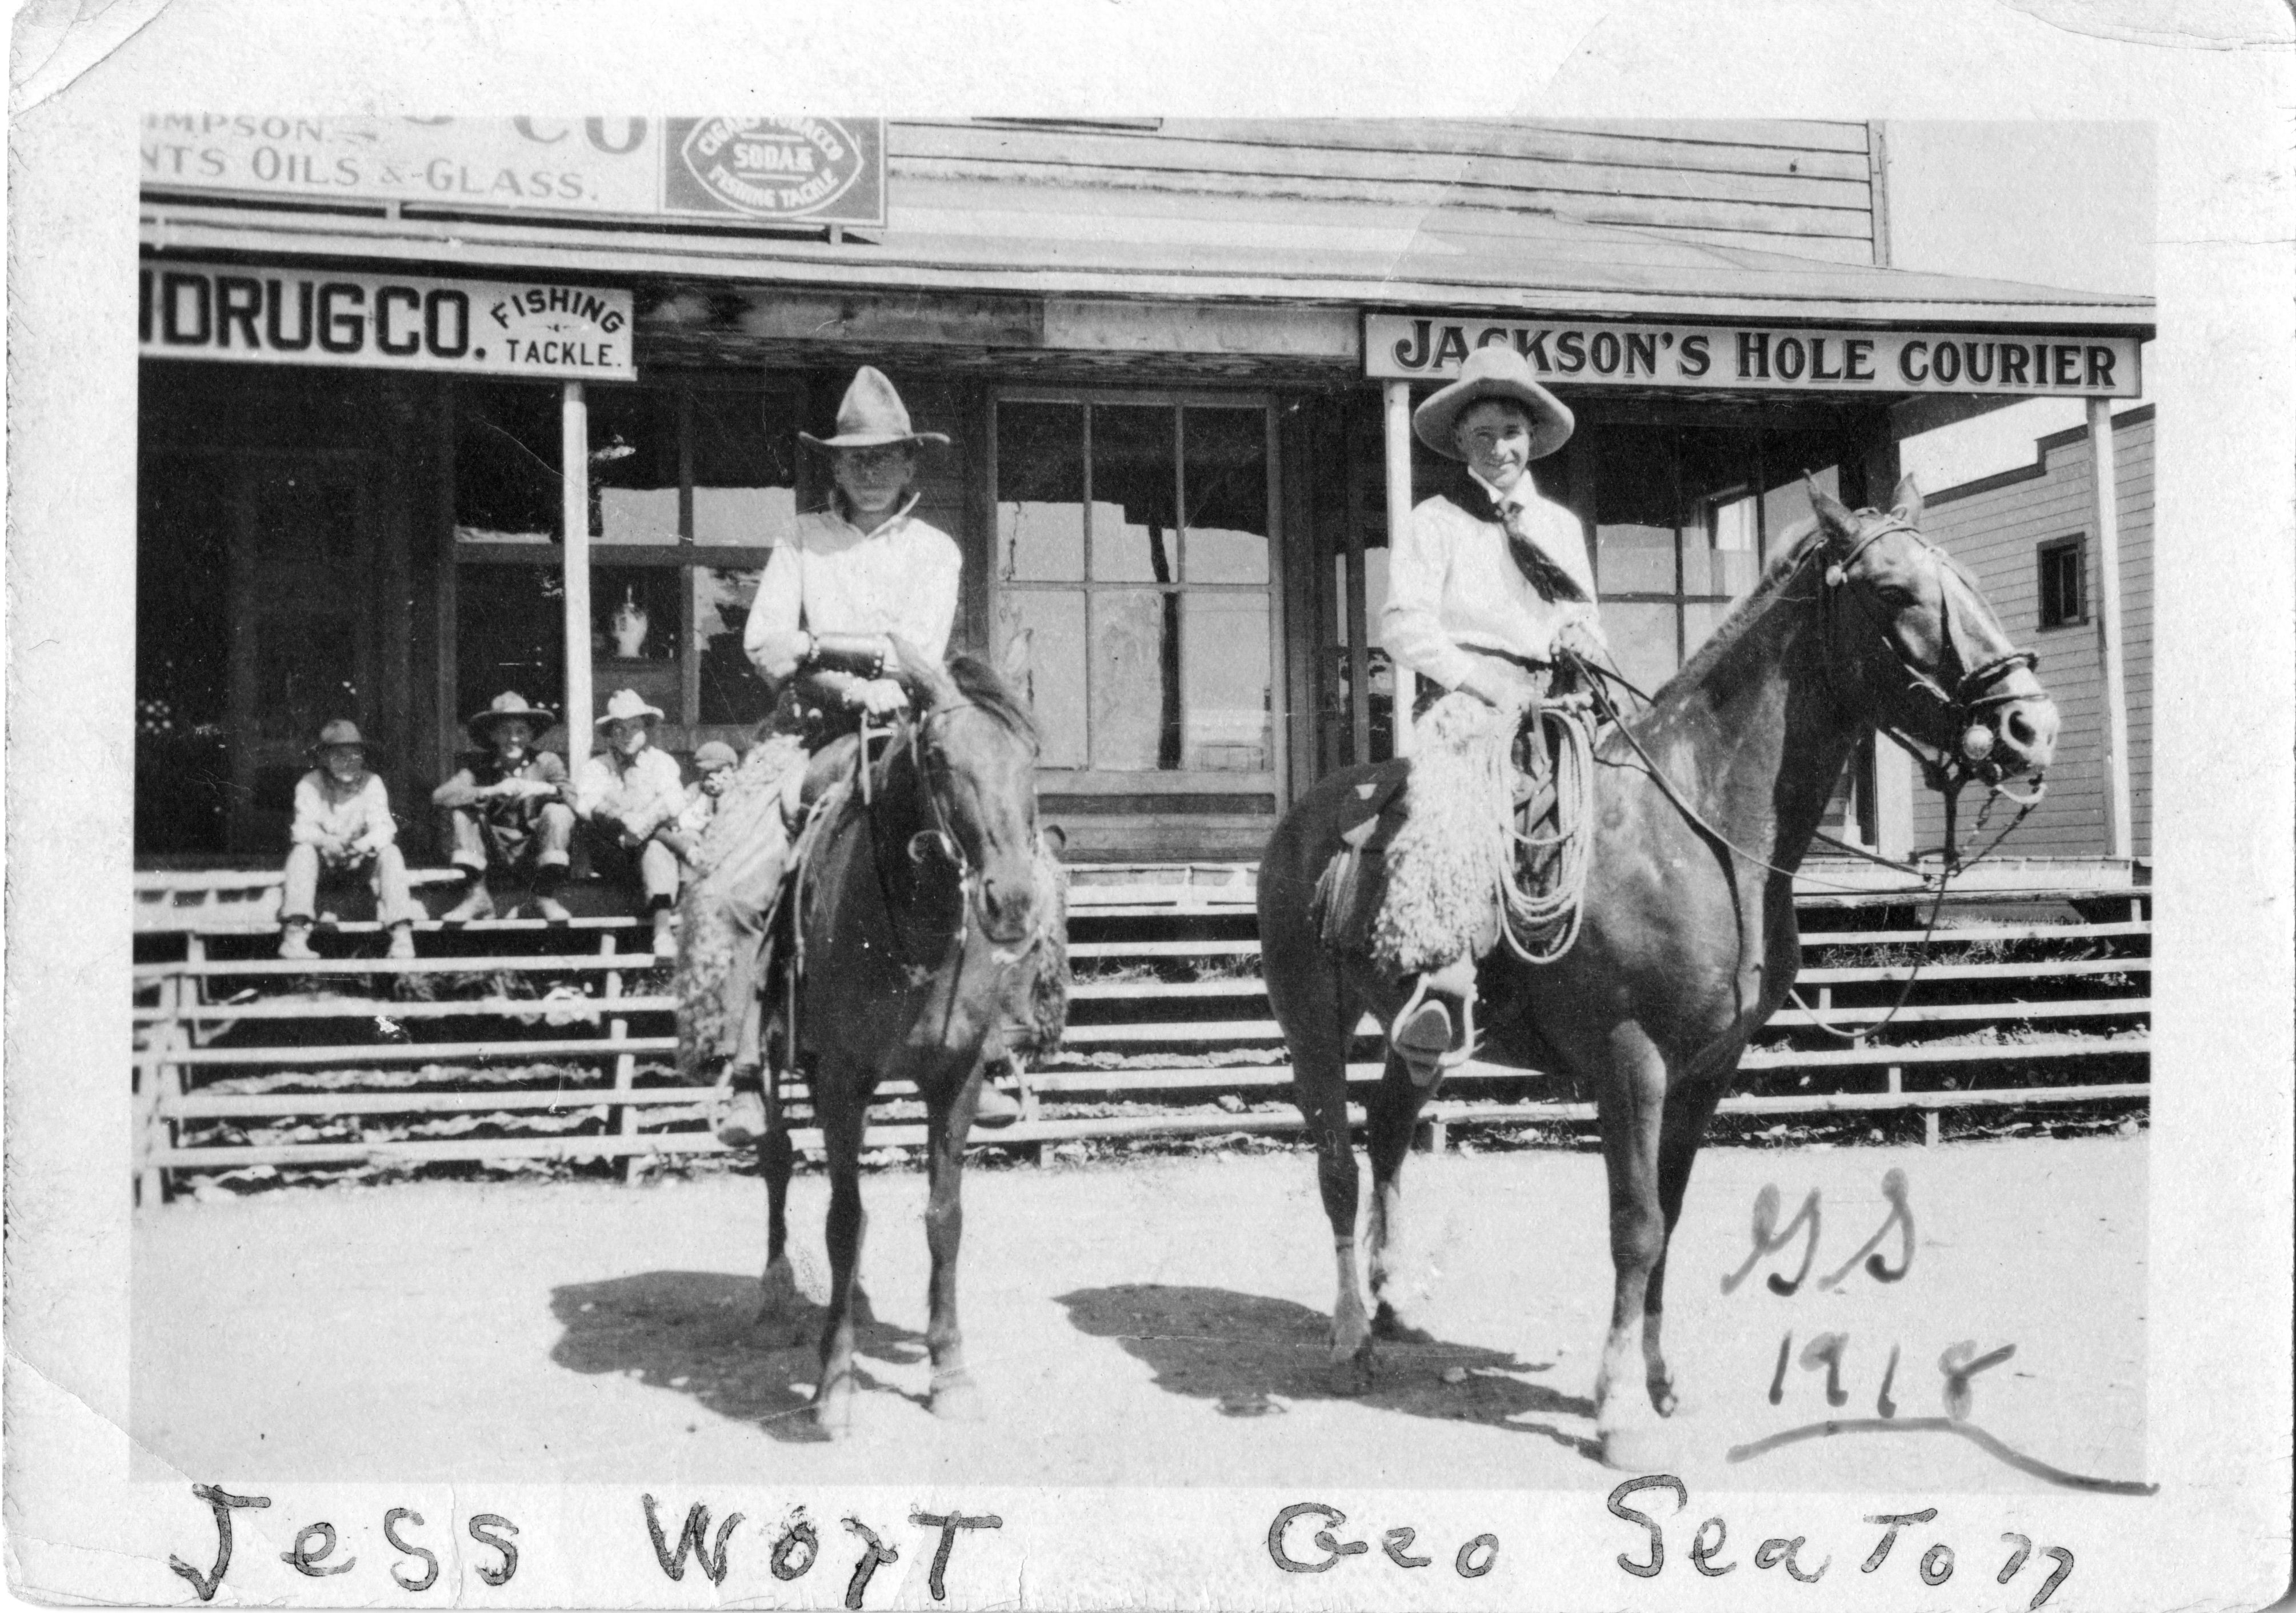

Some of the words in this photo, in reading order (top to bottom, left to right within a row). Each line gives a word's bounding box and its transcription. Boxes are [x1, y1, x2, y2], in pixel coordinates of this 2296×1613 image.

[251, 146, 361, 186] OILS
[779, 167, 840, 209] TACKLE
[490, 286, 625, 334] FISHING
[506, 339, 622, 367] TACKLE.
[1734, 332, 1875, 383] HOLE
[1898, 340, 2117, 389] COURIER
